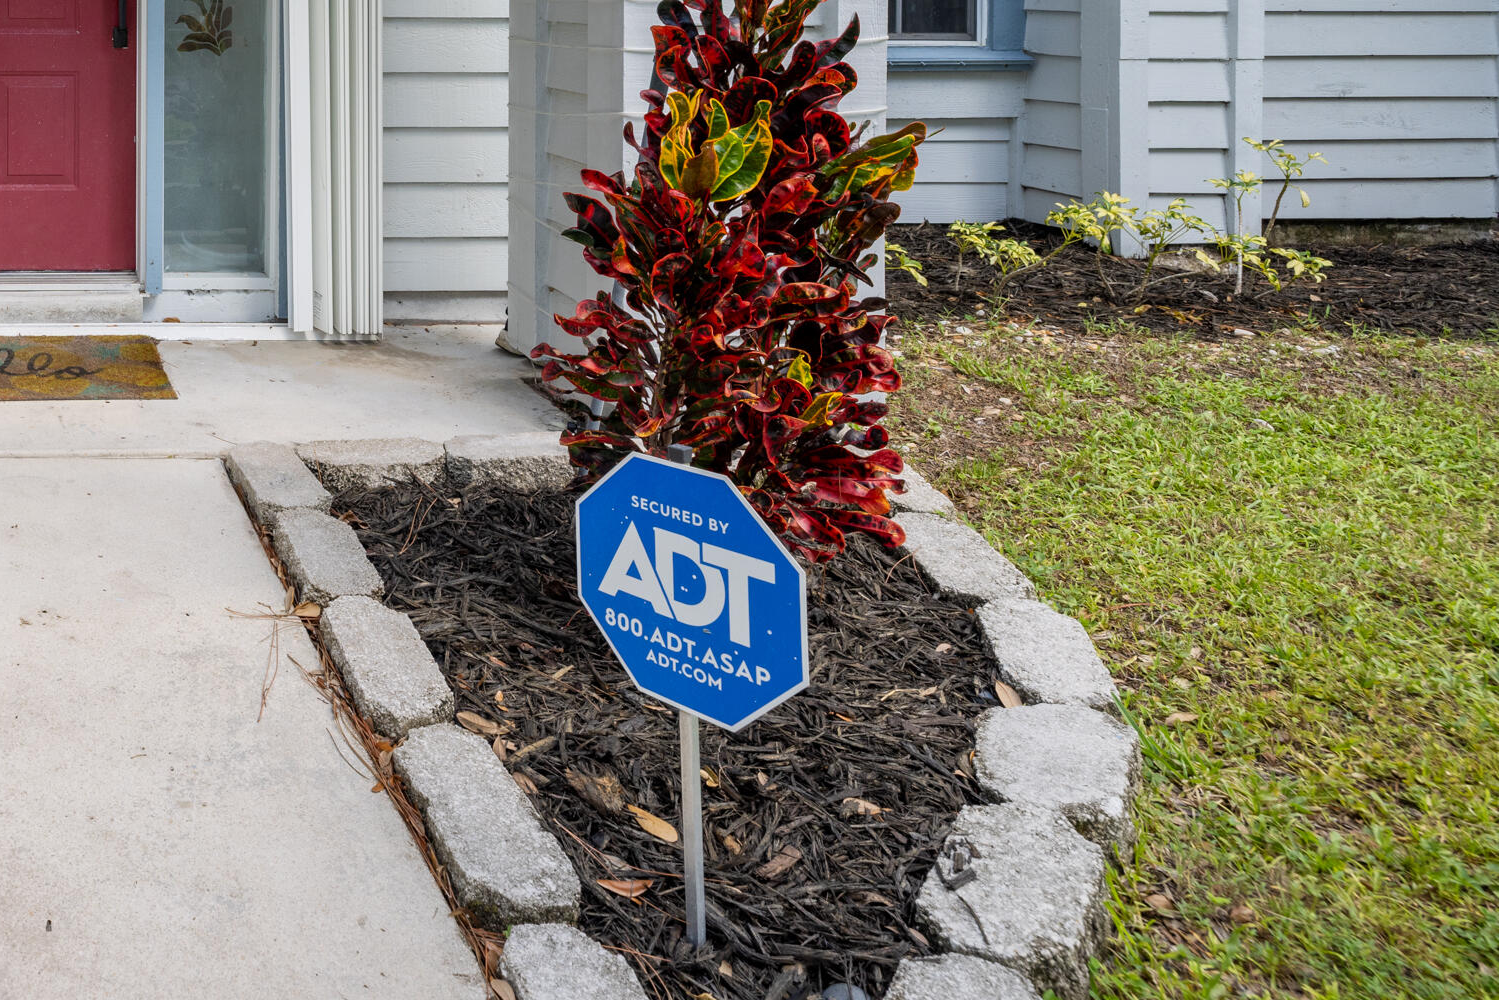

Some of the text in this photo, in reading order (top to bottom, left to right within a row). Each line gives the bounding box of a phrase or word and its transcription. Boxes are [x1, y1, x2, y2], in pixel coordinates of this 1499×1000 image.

[631, 495, 729, 535] SECURED BY
[598, 520, 776, 649] ADT
[604, 607, 771, 686] 800.ADT.ASAP
[645, 649, 722, 691] ADT.COM
